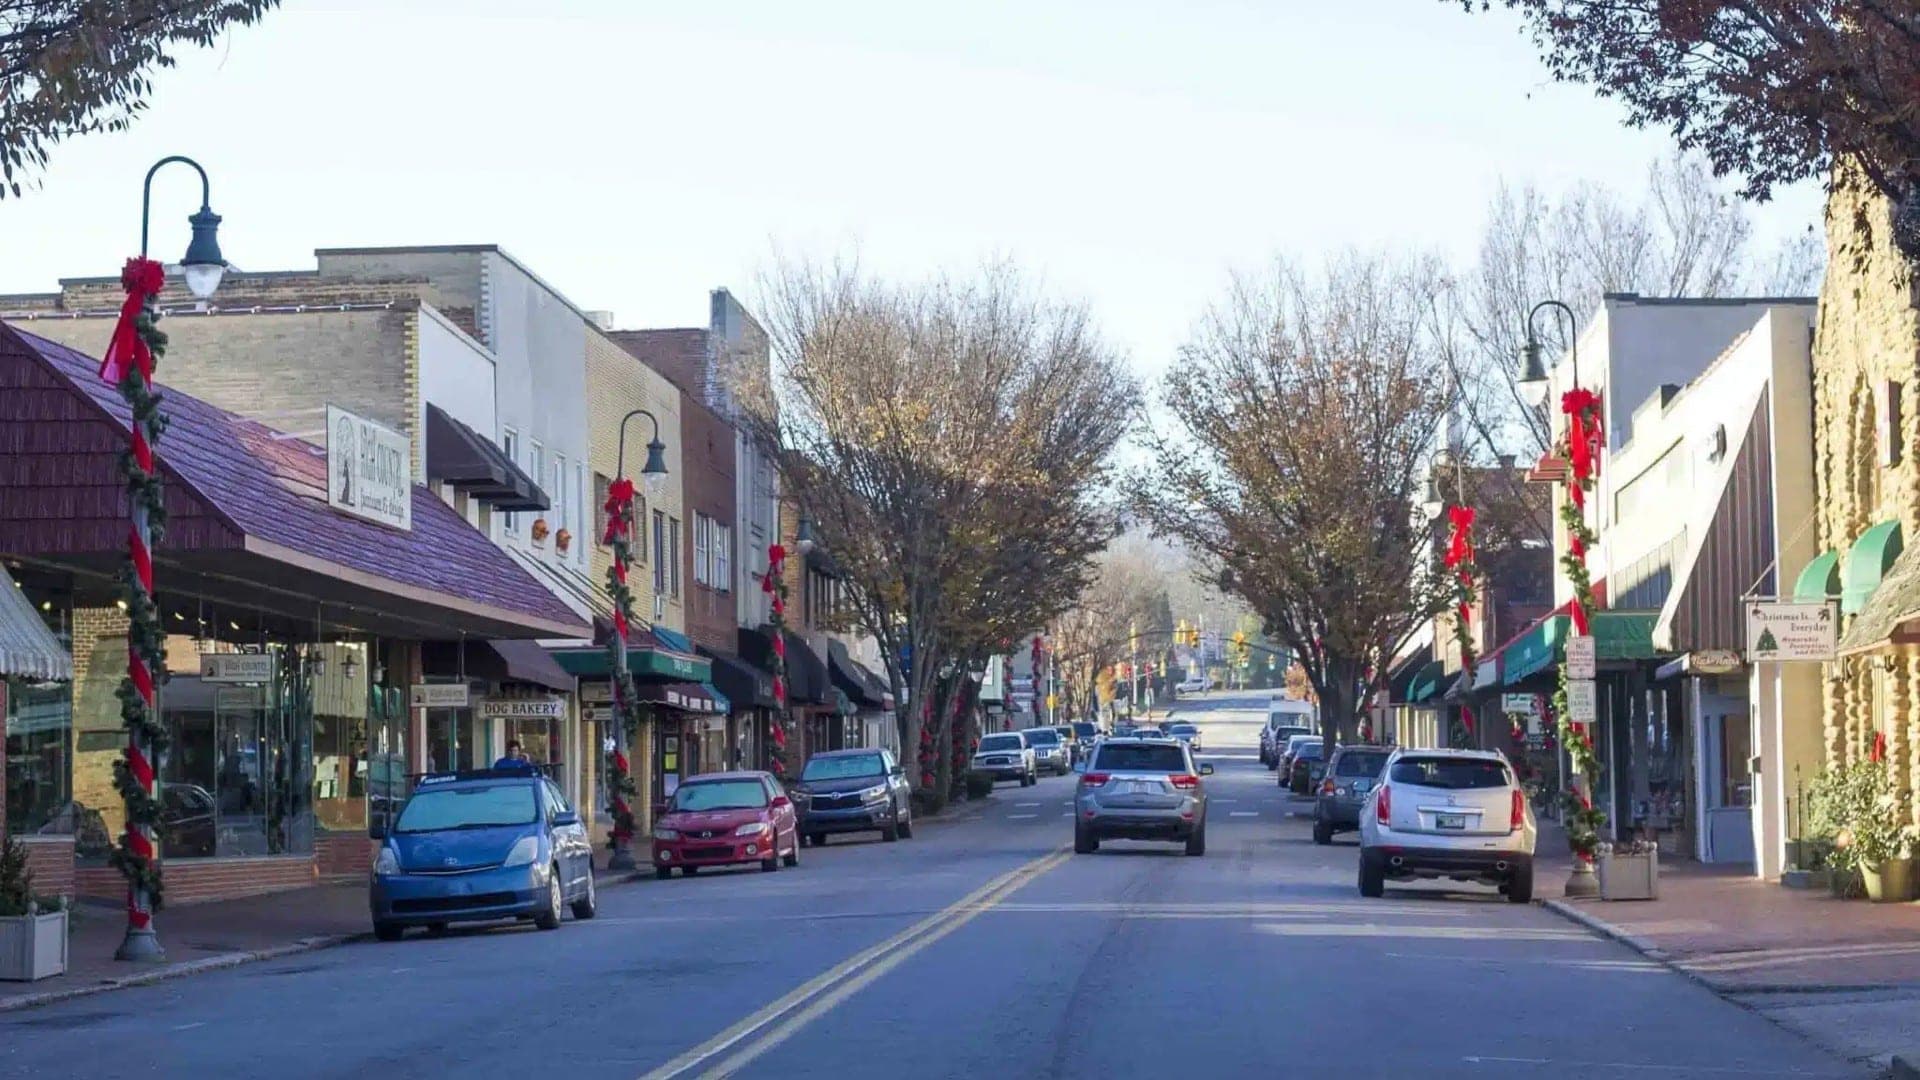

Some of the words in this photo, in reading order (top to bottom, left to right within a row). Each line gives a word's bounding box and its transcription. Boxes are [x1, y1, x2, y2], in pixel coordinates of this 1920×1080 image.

[1791, 622, 1828, 633] Everyday
[484, 703, 508, 715] DOG
[512, 703, 557, 715] BAKERY
